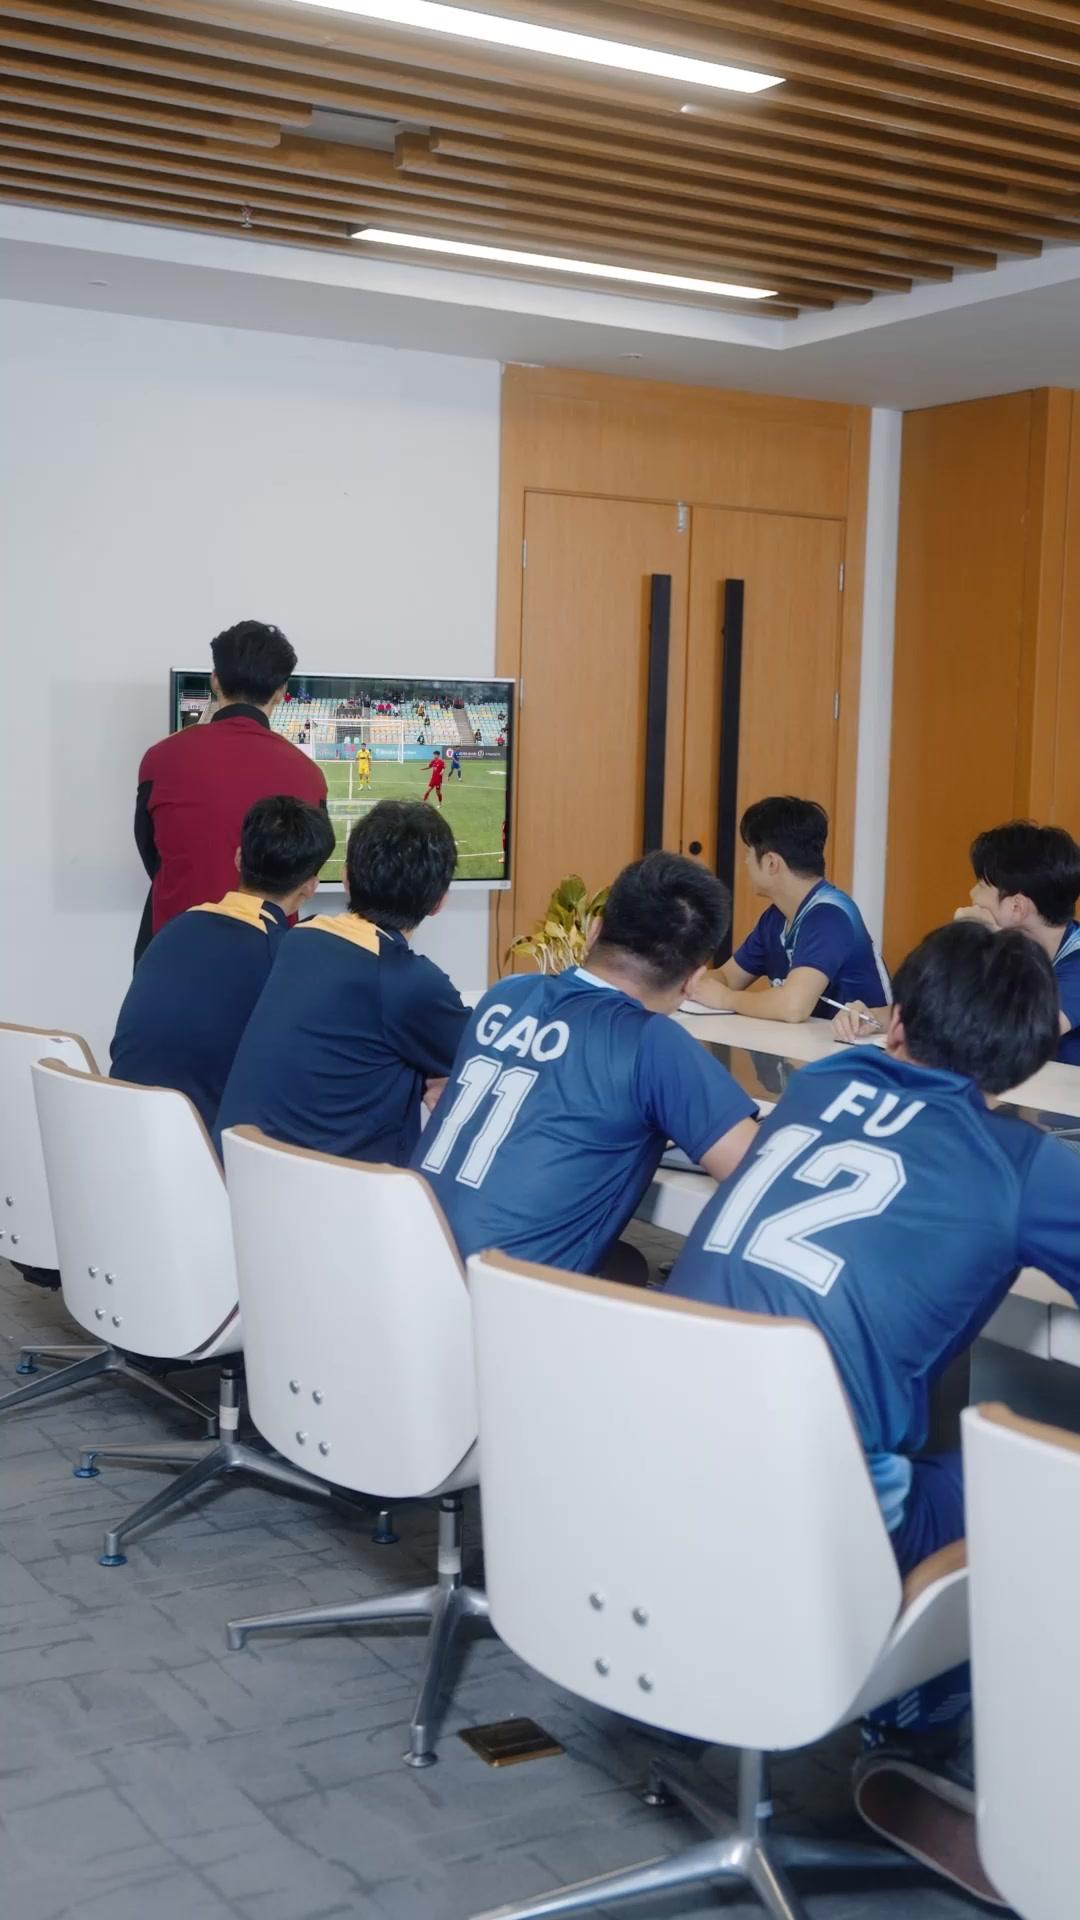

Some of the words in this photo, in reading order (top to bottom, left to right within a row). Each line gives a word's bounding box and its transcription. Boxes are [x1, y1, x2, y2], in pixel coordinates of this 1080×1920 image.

[475, 1004, 570, 1062] GAO
[421, 1054, 539, 1189] 11
[819, 1080, 927, 1138] FU
[702, 1123, 907, 1297] 12
